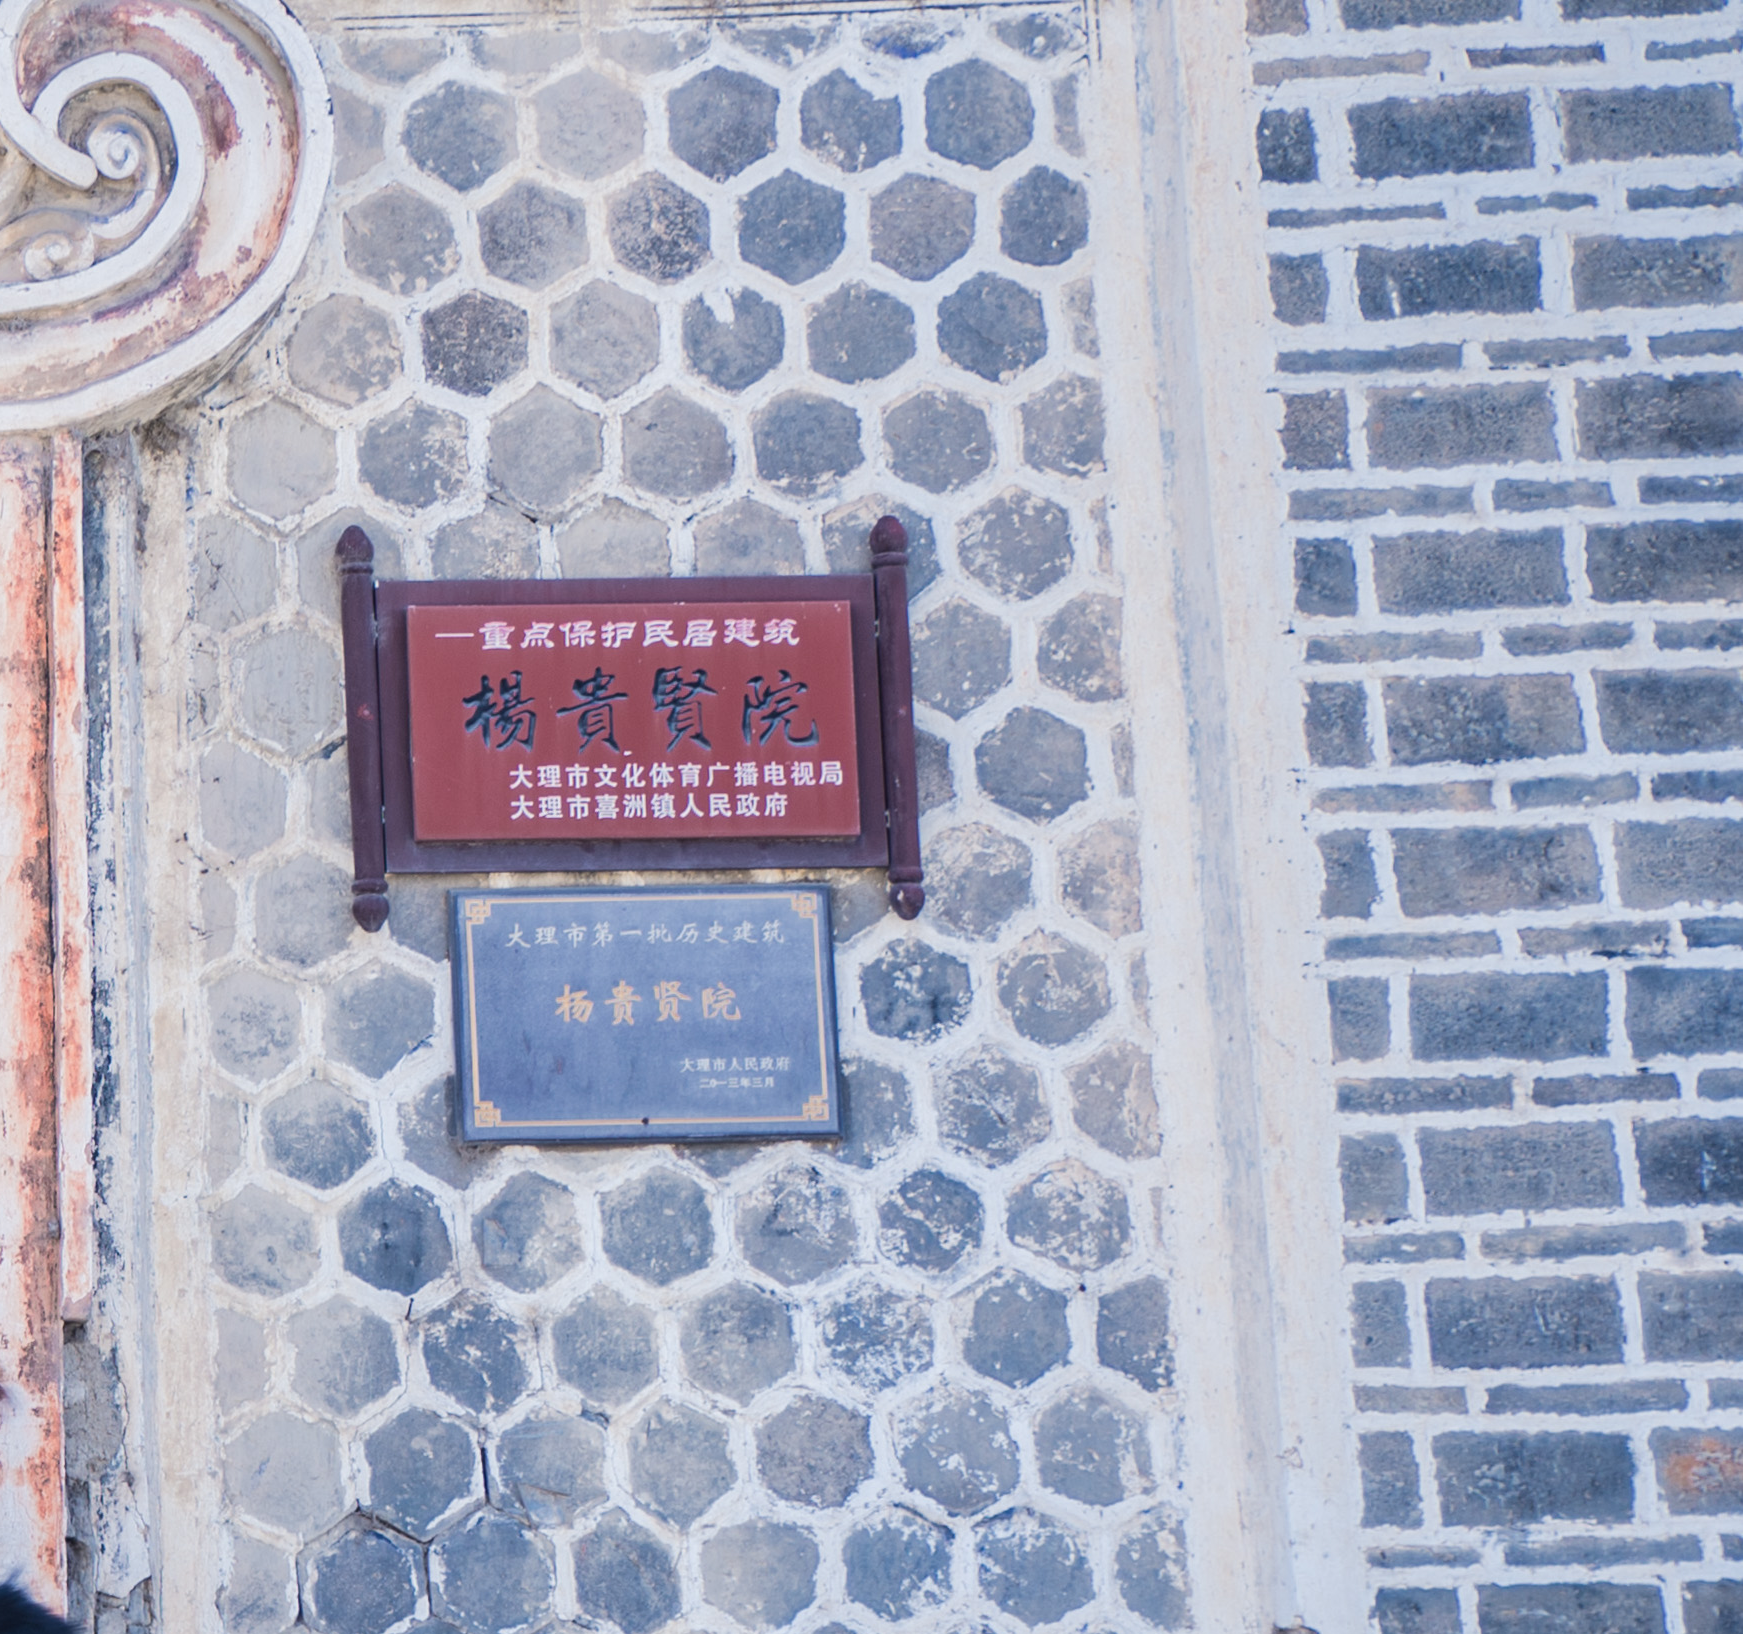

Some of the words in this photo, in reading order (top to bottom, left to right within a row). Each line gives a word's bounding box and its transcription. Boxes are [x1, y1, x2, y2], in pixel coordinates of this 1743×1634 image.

[462, 665, 819, 754] 楊貴賢院
[509, 760, 844, 791] 大理市文化体育广播电视局
[510, 792, 789, 820] 大理市喜洲镇人民政府
[505, 919, 786, 949] 大理市第一批历史建筑
[555, 979, 742, 1026] 杨贵贤院
[679, 1056, 791, 1073] 大理市人民政府
